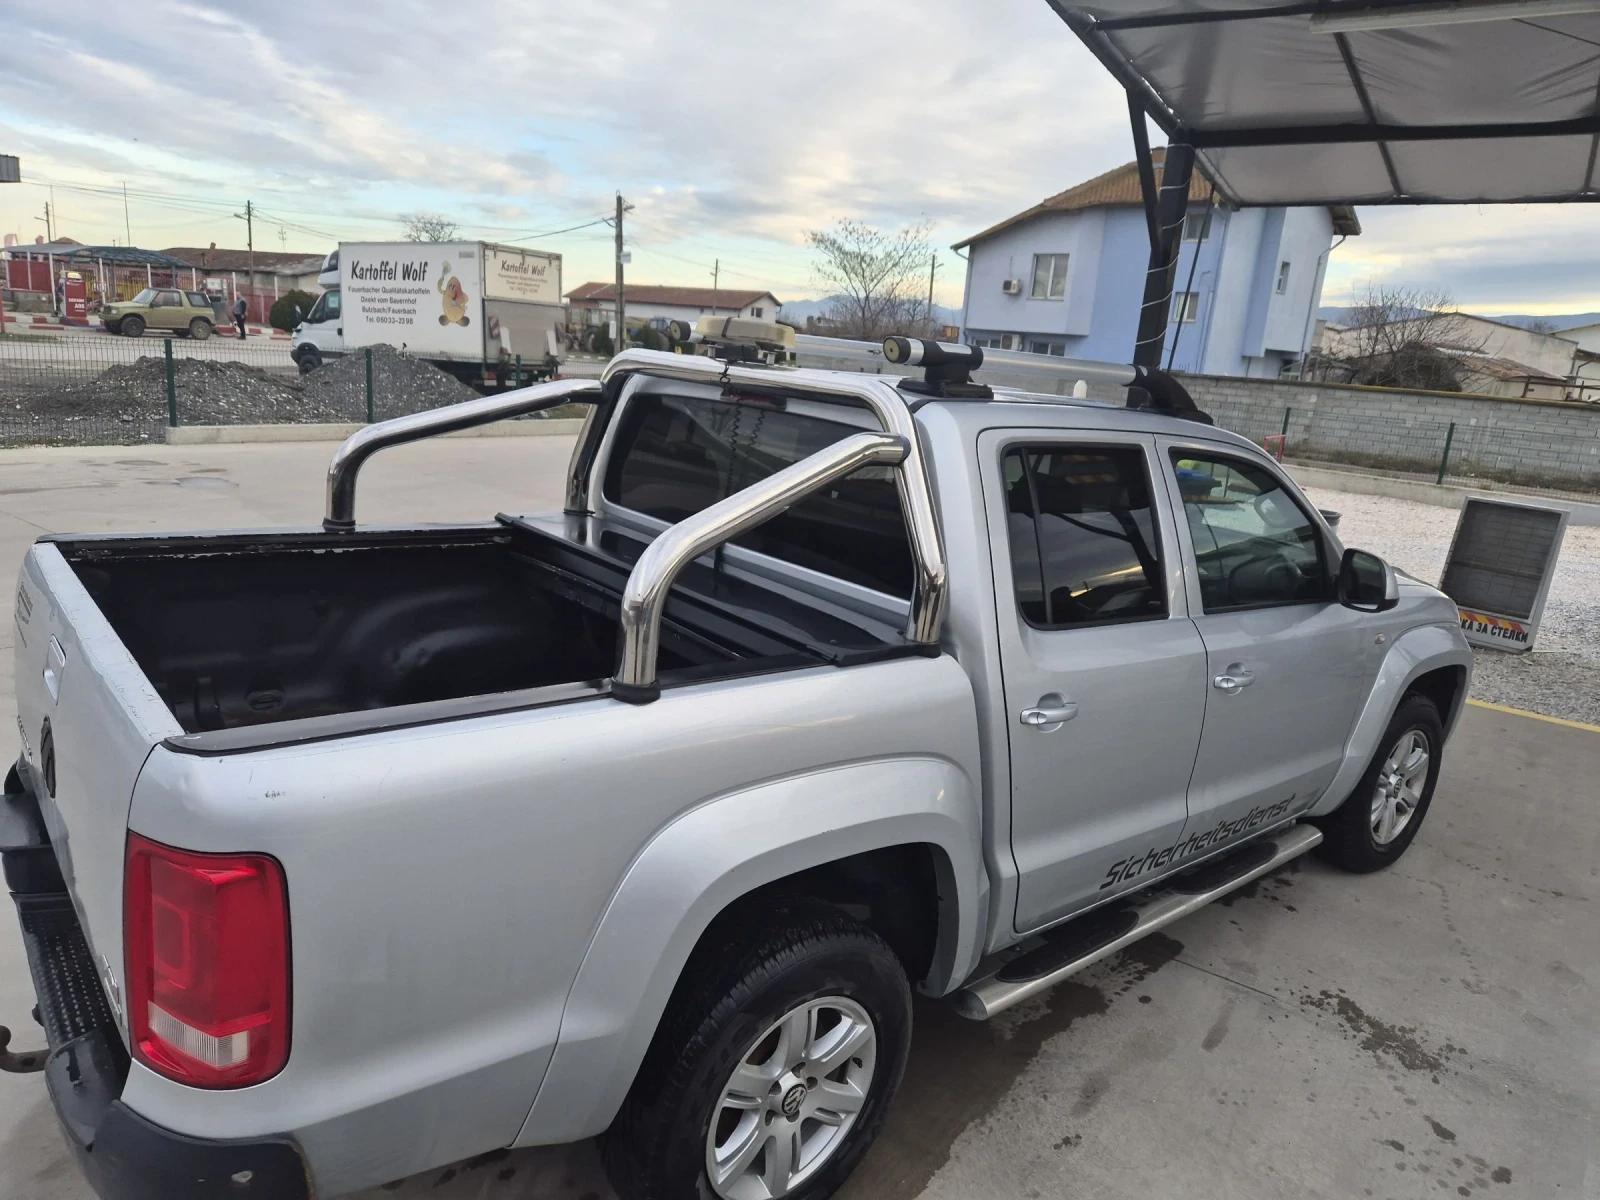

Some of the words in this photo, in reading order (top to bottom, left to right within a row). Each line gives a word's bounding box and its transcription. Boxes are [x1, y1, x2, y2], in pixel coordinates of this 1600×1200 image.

[351, 260, 398, 281] Kartoffel
[402, 261, 429, 282] Wolf
[501, 260, 529, 275] Kartoffel
[532, 264, 546, 276] Wolf
[348, 285, 380, 294] Fauerbacher
[381, 286, 431, 295] Qualitätskartoffeln
[389, 296, 417, 305] Bauernhof
[362, 306, 416, 314] Butzbach/Fauerbach
[366, 315, 375, 323] Tel.
[1460, 617, 1474, 631] КА
[1476, 622, 1488, 634] ЗА
[1491, 626, 1529, 643] СТЕЛКИ
[1099, 792, 1297, 891] Sicherheitsdienst
